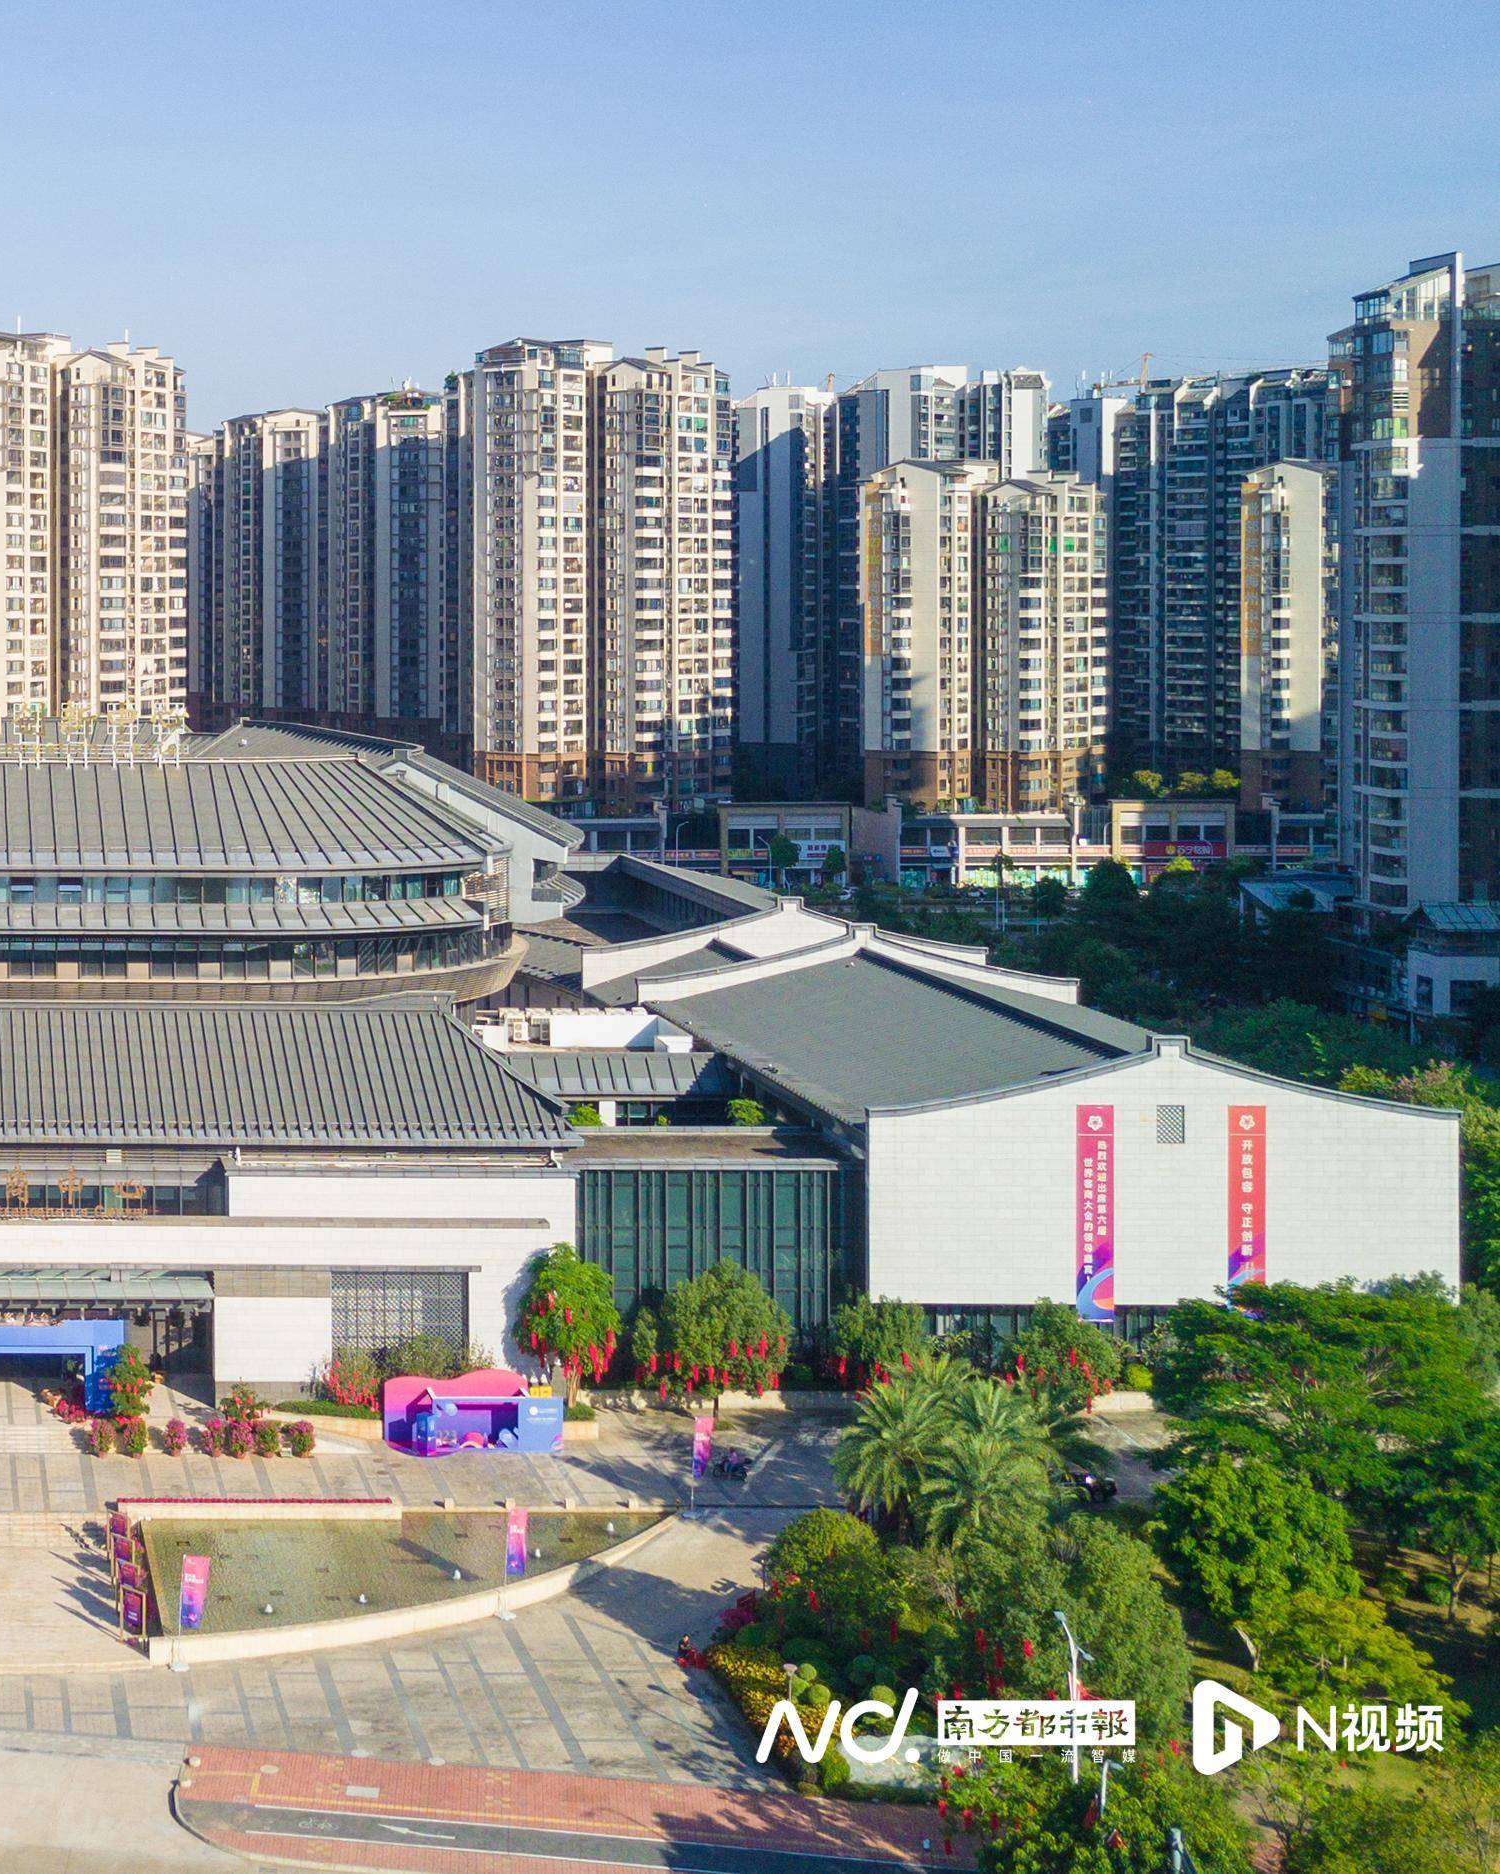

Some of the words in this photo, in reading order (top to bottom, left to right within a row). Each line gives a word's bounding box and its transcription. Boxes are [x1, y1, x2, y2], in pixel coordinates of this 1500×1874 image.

[1241, 1139, 1254, 1193] 开放包容
[1241, 1202, 1254, 1256] 守正创新
